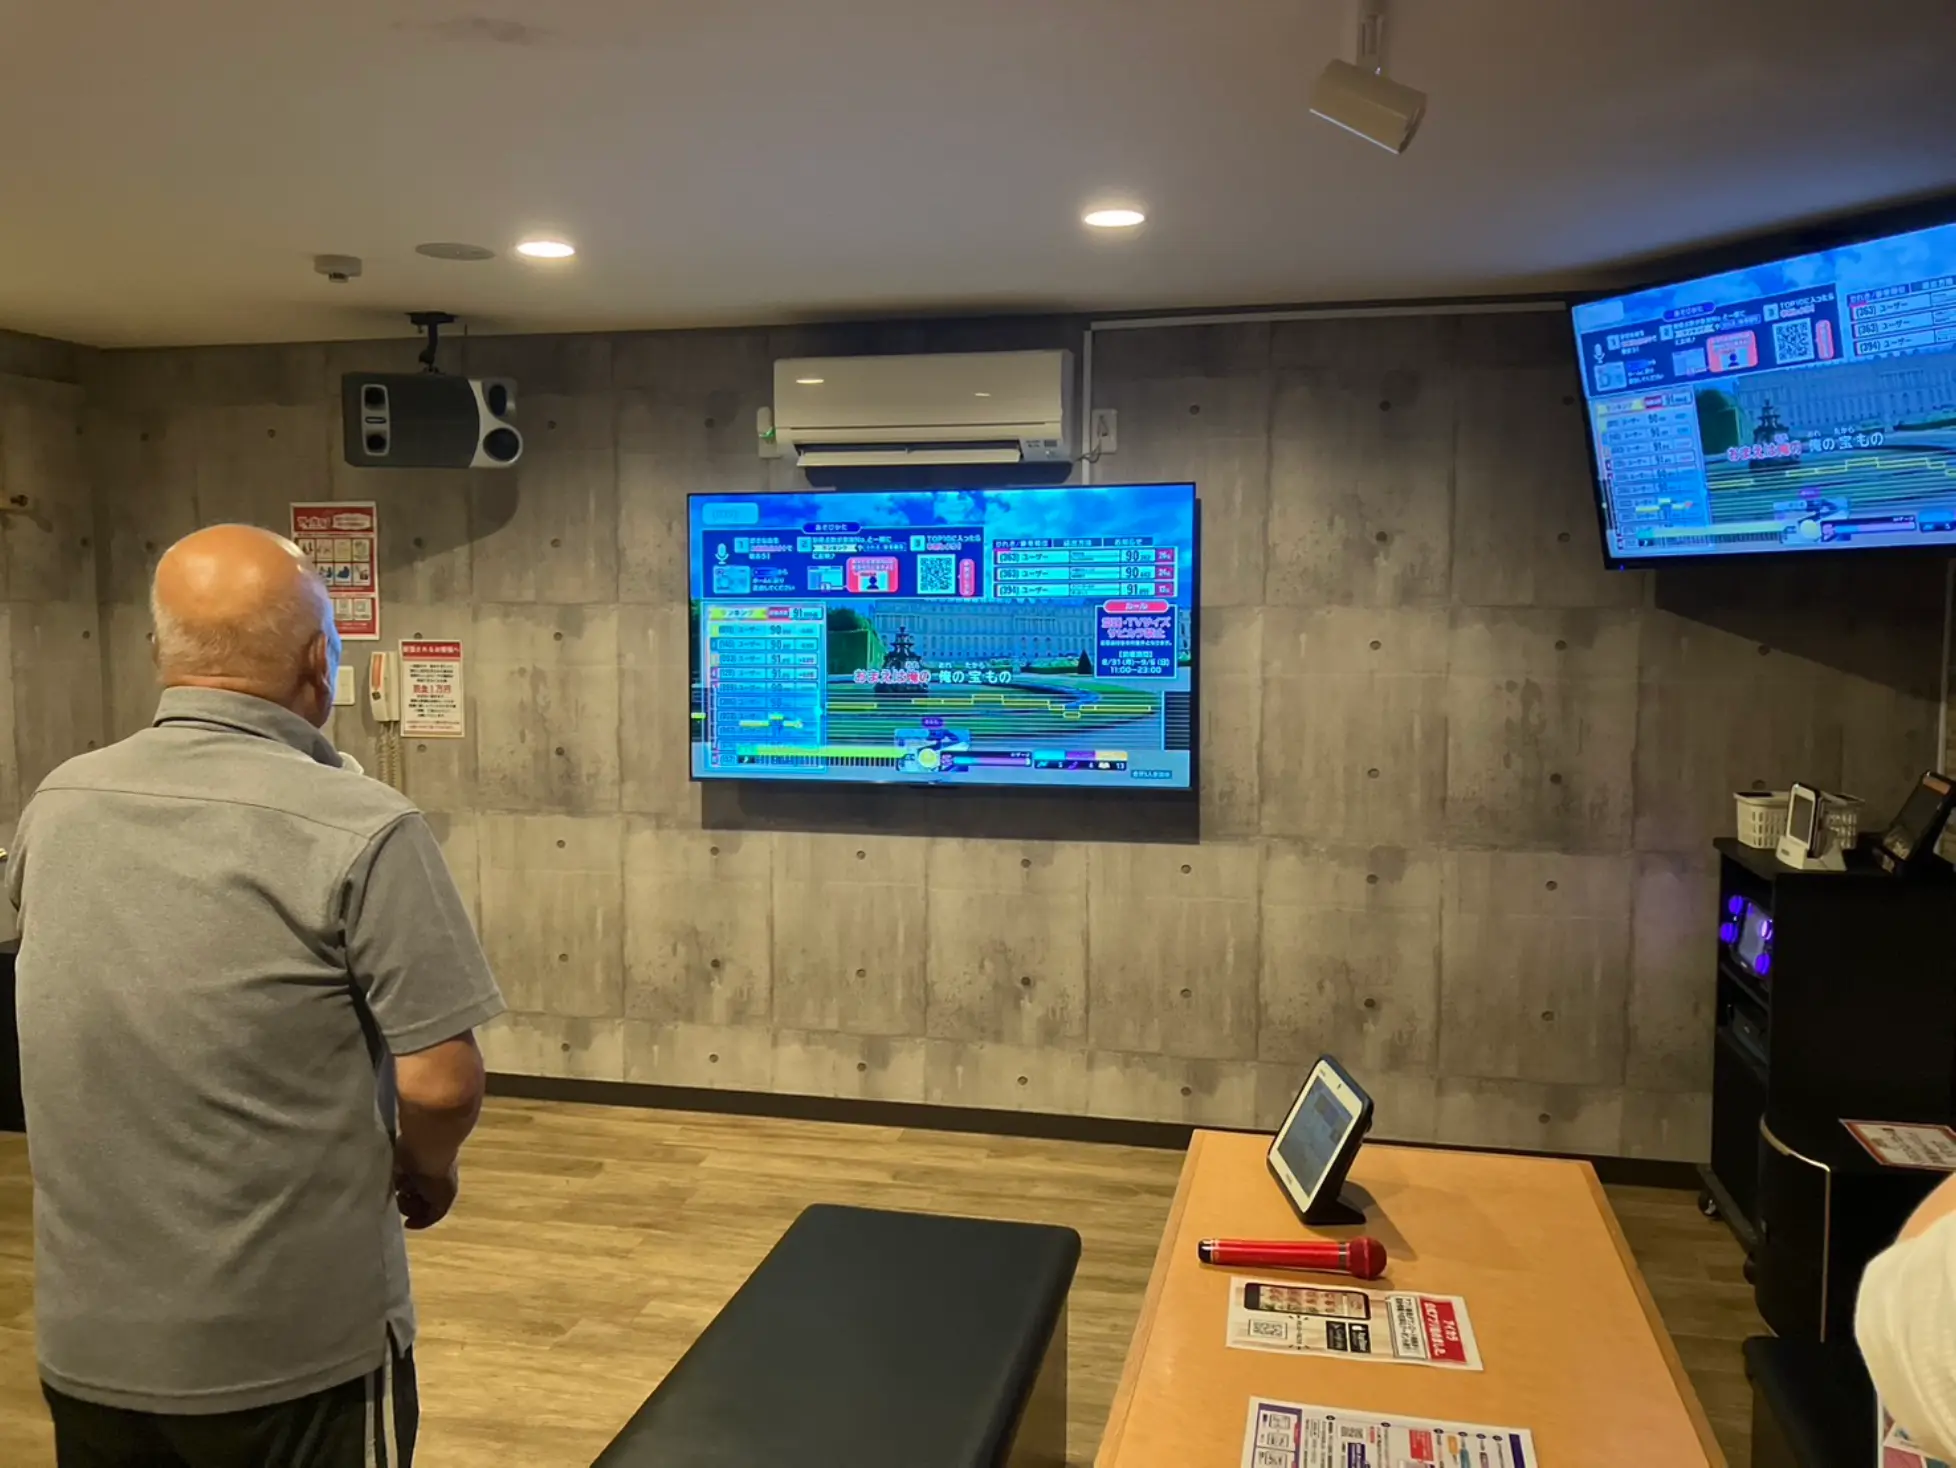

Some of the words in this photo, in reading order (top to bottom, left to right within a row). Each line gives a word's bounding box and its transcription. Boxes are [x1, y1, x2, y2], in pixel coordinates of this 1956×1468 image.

[1021, 553, 1049, 561] ユーザー
[1021, 570, 1049, 578] ユーザー
[1021, 586, 1049, 594] ユーザー
